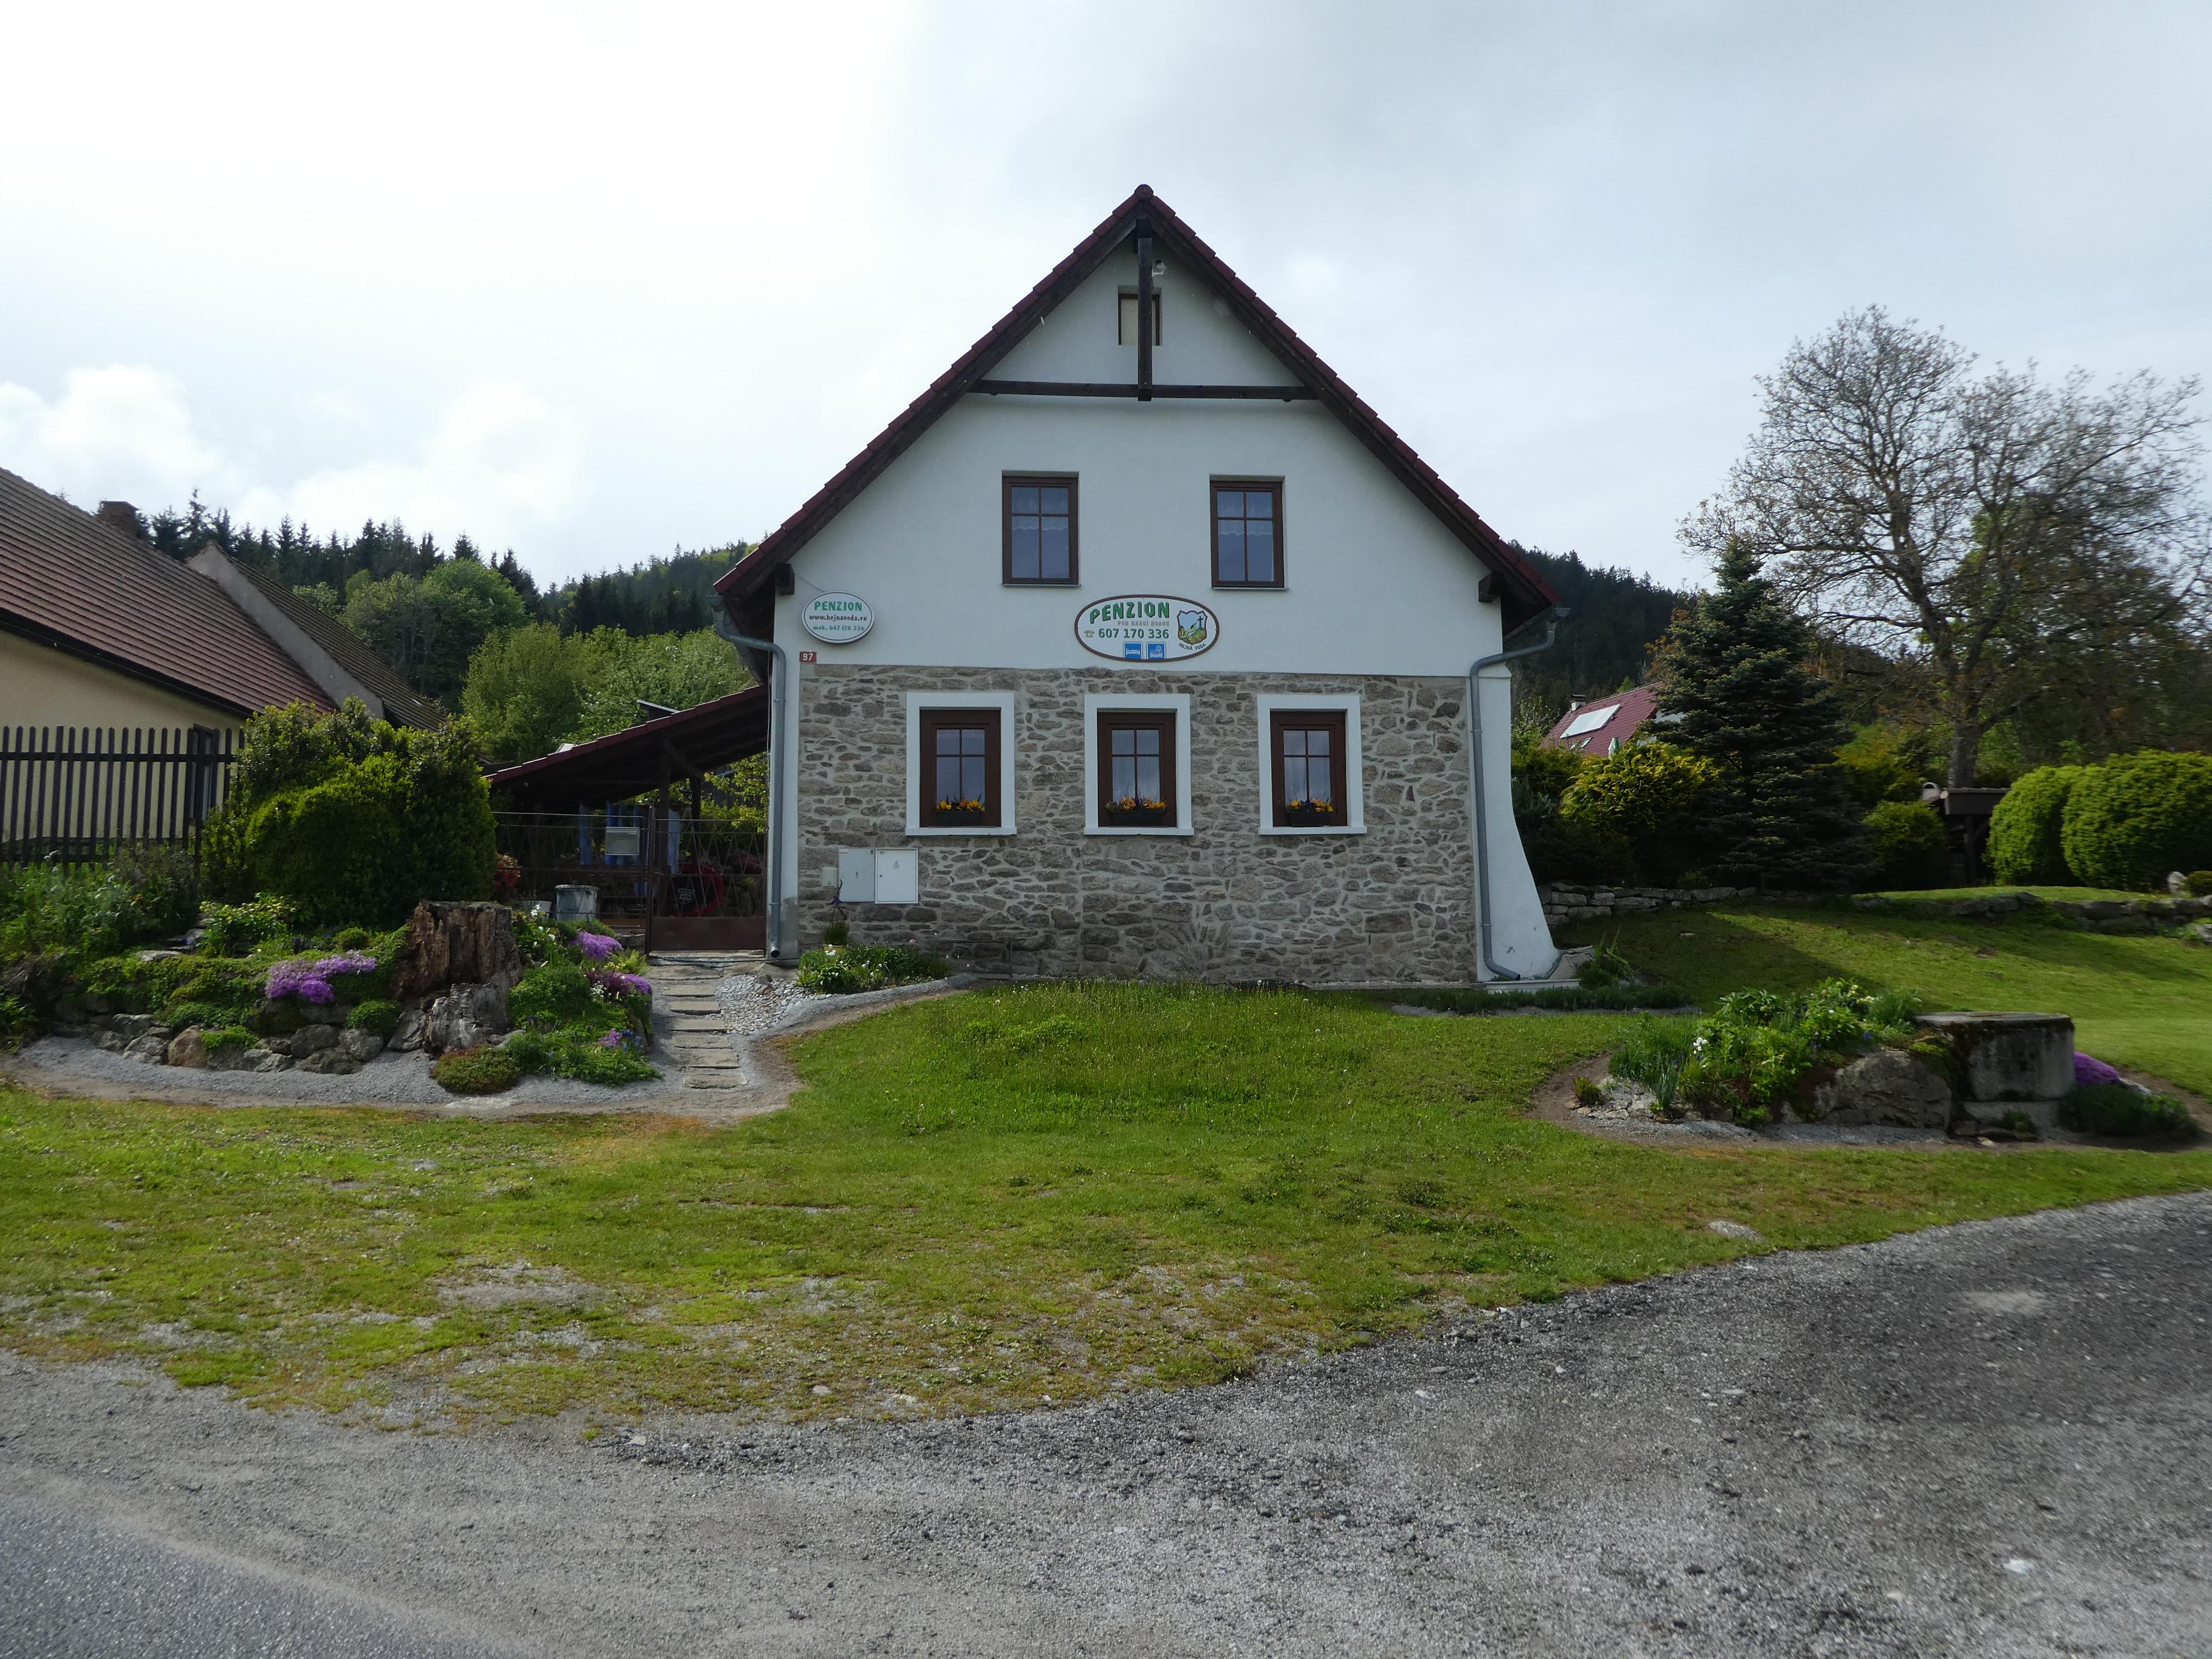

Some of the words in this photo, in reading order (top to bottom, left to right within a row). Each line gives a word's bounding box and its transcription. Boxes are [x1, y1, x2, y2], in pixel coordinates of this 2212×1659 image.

[814, 601, 862, 611] PENZION
[1089, 601, 1170, 624] PENZION
[1098, 629, 1119, 638] 607
[1123, 629, 1144, 638] 170
[1148, 629, 1169, 639] 336
[803, 653, 813, 661] 97
